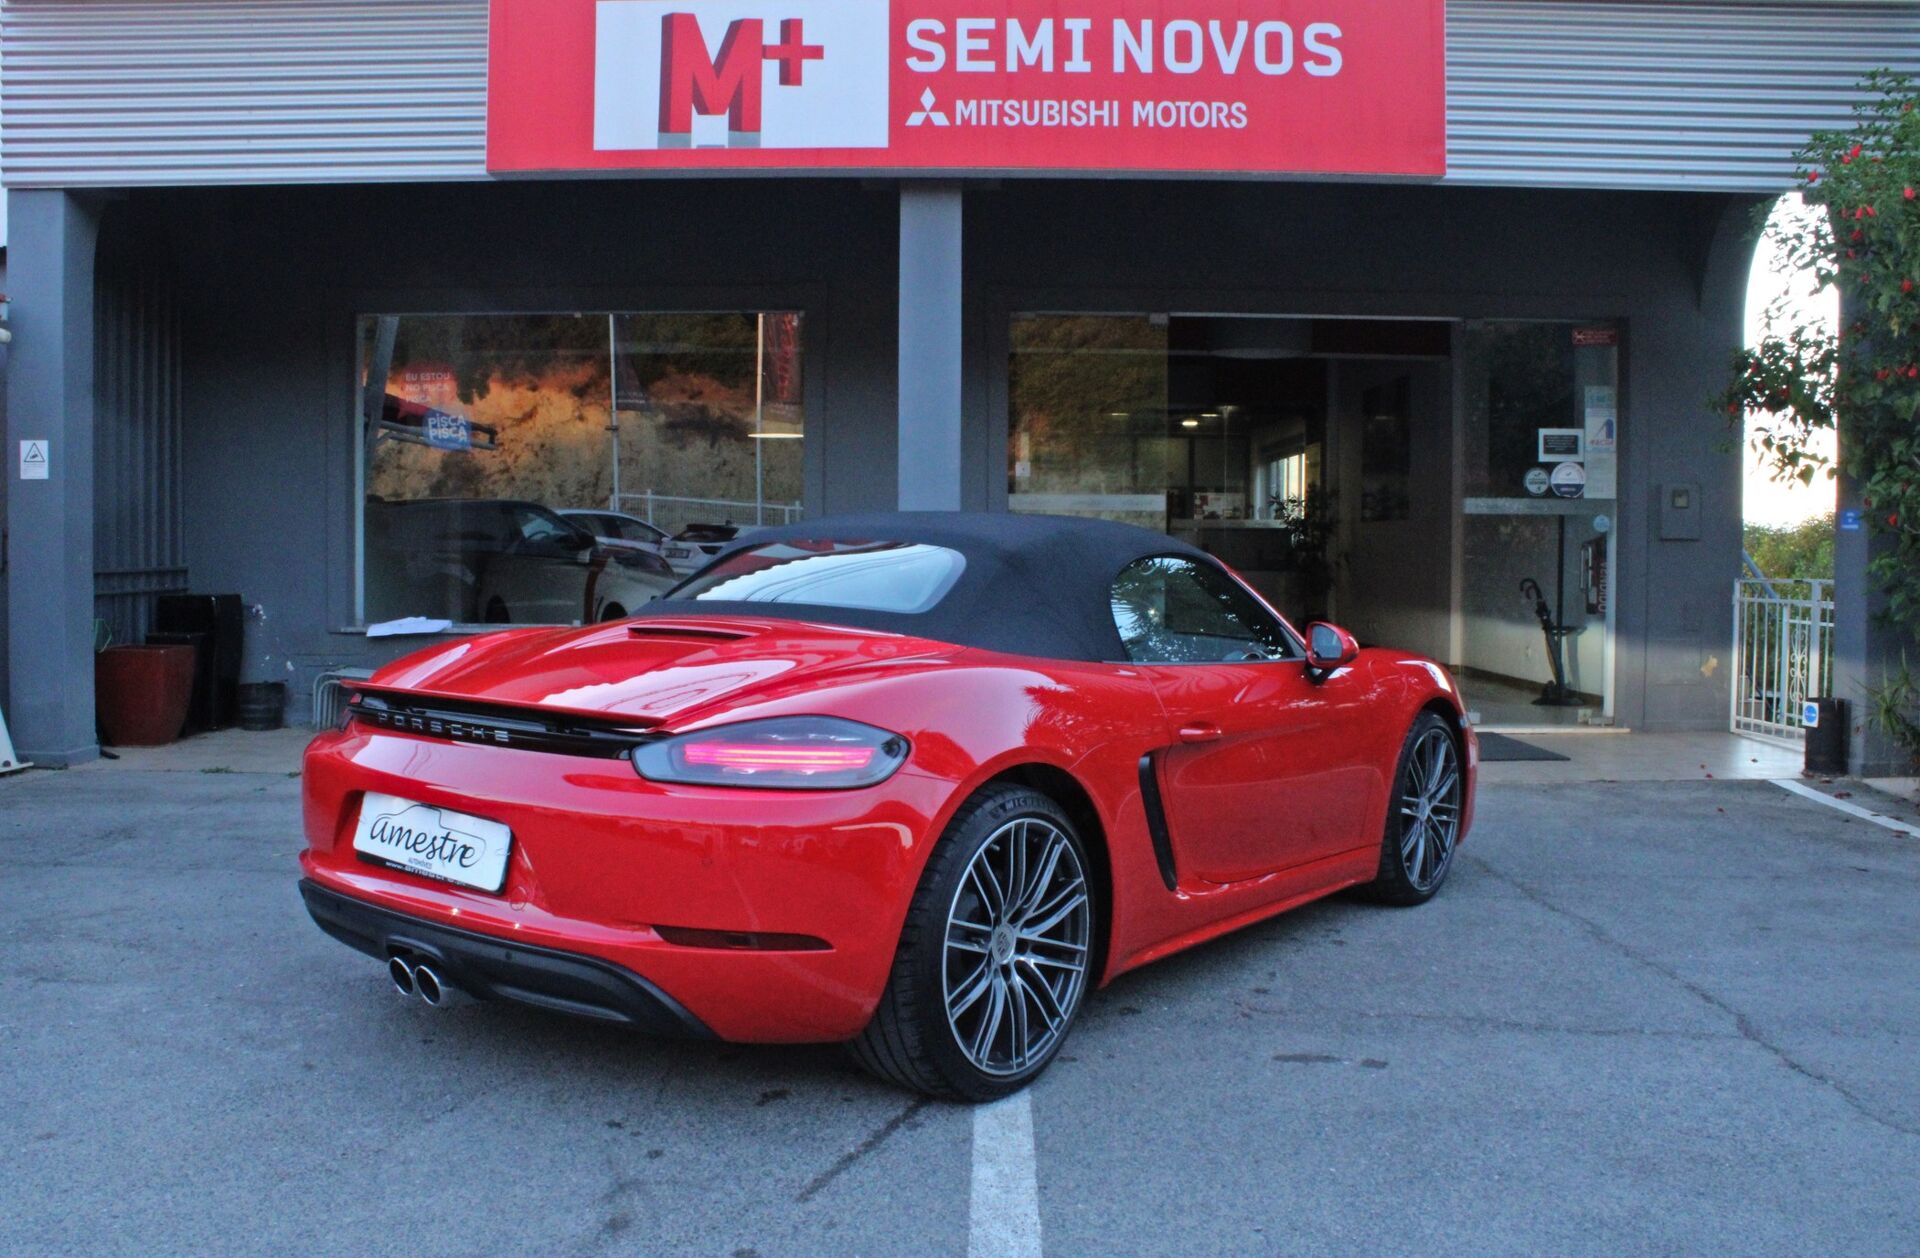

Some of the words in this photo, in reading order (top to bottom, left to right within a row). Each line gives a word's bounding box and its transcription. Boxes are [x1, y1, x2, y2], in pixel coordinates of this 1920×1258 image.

[905, 17, 1092, 73] SEMI
[1112, 17, 1343, 77] NOVOS
[955, 99, 1119, 127] MITSUBISHI
[1132, 100, 1248, 129] MOTORS
[420, 371, 450, 381] ESTOU
[377, 711, 509, 742] PORSCHE
[370, 816, 476, 868] amestre
